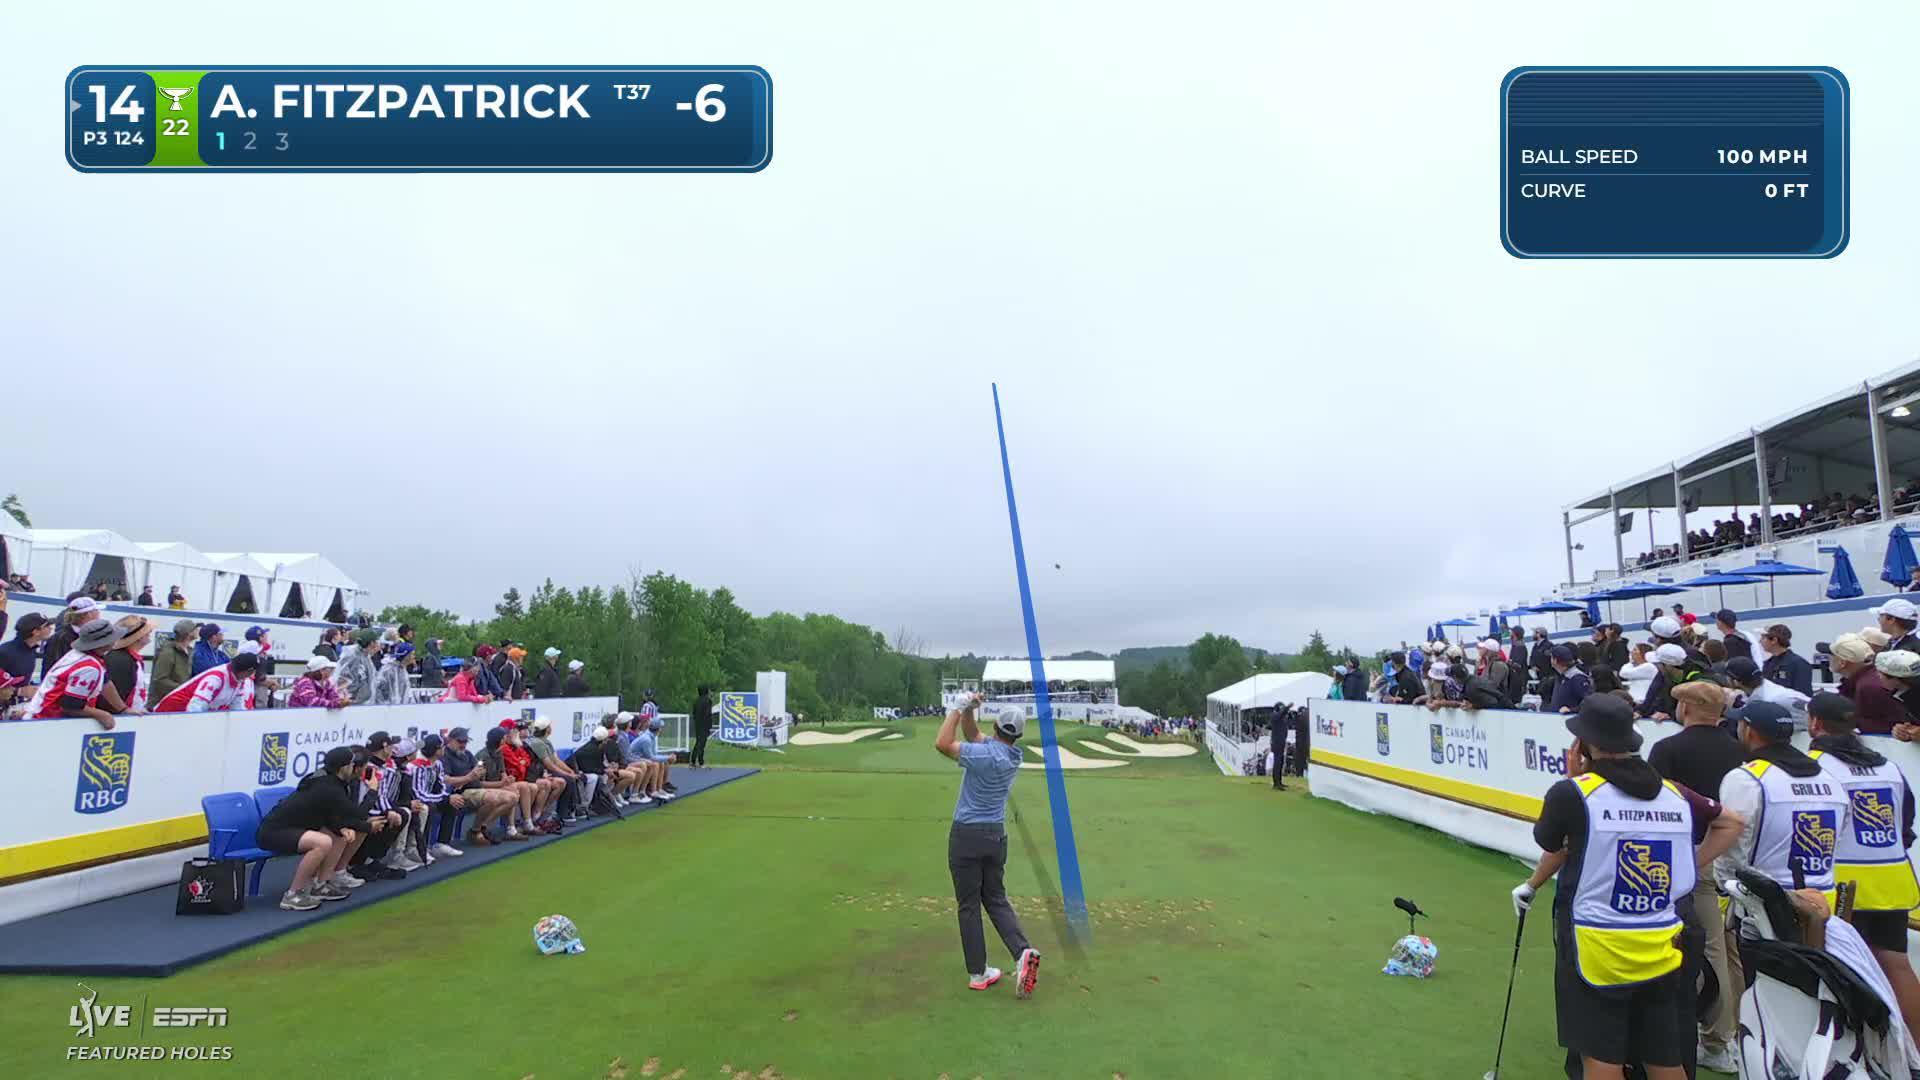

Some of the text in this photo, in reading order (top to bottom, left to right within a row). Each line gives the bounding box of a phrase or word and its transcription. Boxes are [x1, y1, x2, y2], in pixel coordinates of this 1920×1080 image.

[295, 725, 364, 745] CANADIAN
[724, 727, 756, 739] RBC
[1445, 726, 1487, 742] CANADIAN
[1446, 743, 1488, 770] OPEN
[260, 769, 285, 784] RBC
[1791, 783, 1832, 796] GRILLO
[80, 787, 125, 810] RBC
[1602, 809, 1684, 823] A. FITZPATRICK
[1860, 829, 1897, 845] RBC
[1617, 892, 1666, 913] RBC
